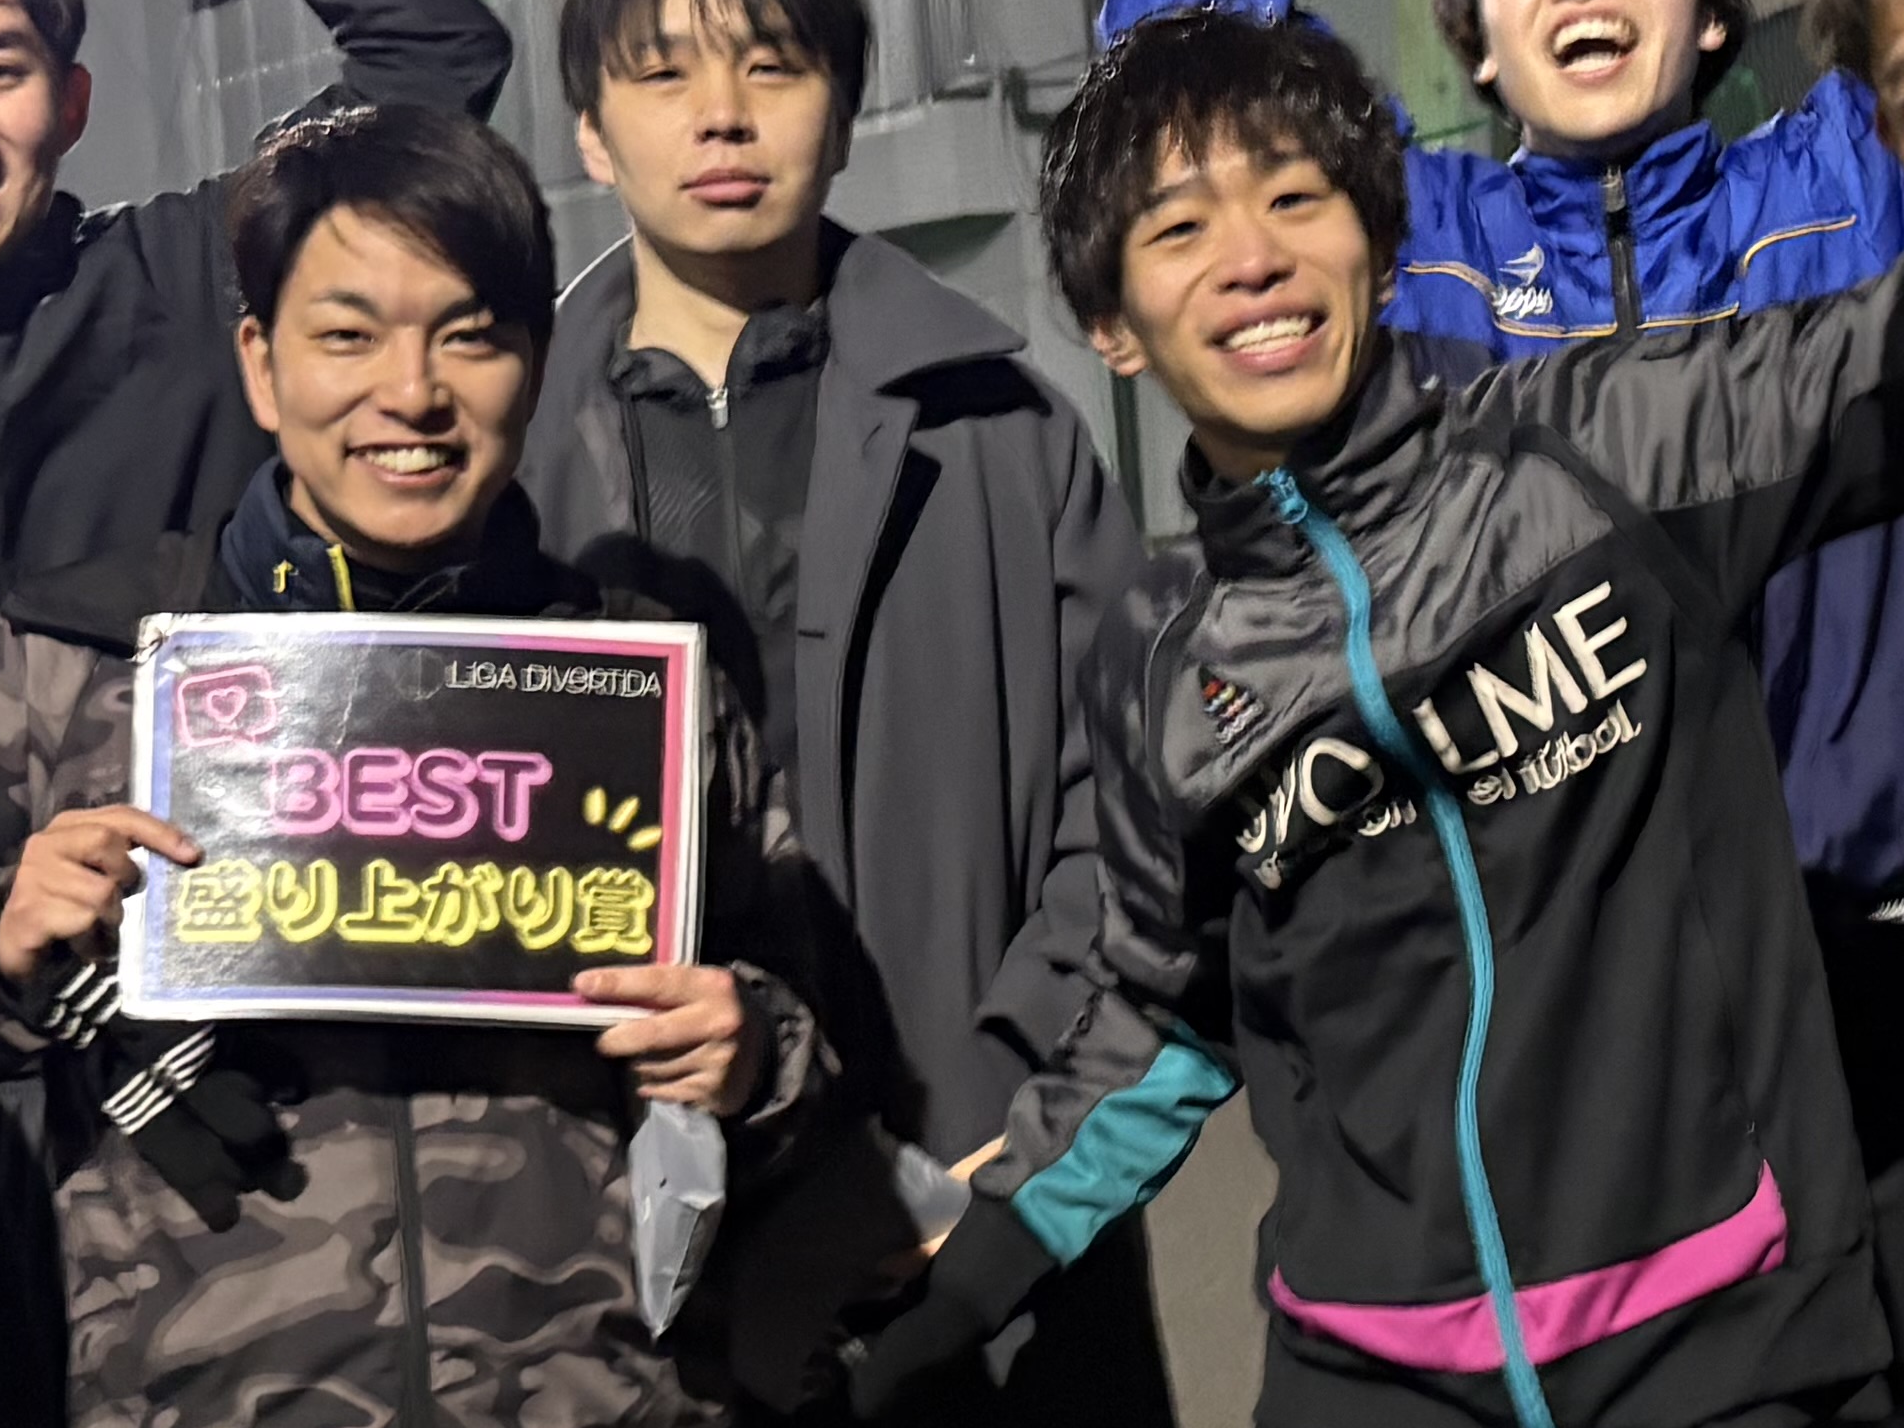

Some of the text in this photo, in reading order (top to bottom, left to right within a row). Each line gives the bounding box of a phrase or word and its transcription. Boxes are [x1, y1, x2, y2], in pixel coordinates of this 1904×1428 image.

[445, 660, 518, 691] LIGA
[272, 747, 552, 842] BEST
[176, 859, 655, 955] 盛り上がり賞
